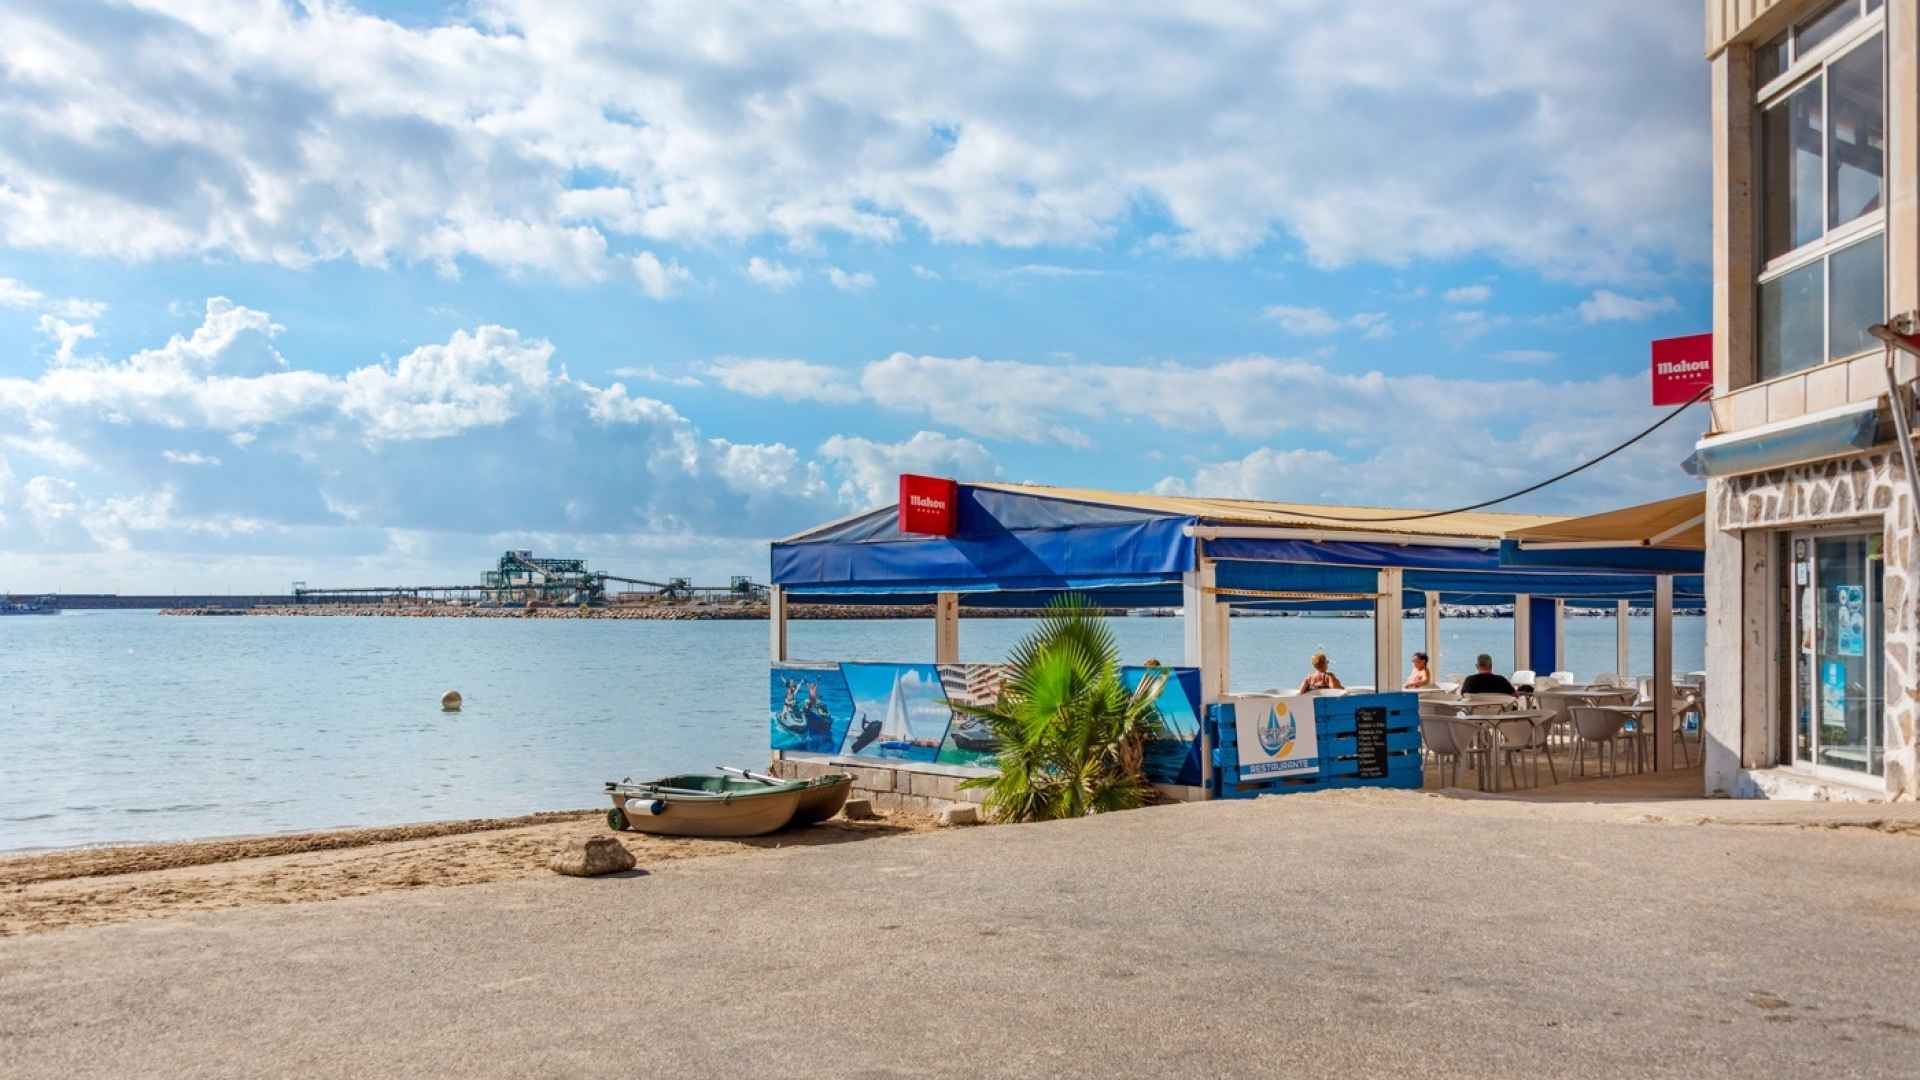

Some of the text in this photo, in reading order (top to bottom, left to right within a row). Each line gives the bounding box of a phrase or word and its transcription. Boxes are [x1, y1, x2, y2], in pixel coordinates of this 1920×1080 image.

[1657, 359, 1710, 375] Mahou
[910, 494, 946, 510] Mahou
[1249, 759, 1309, 775] RESTAURANTE
